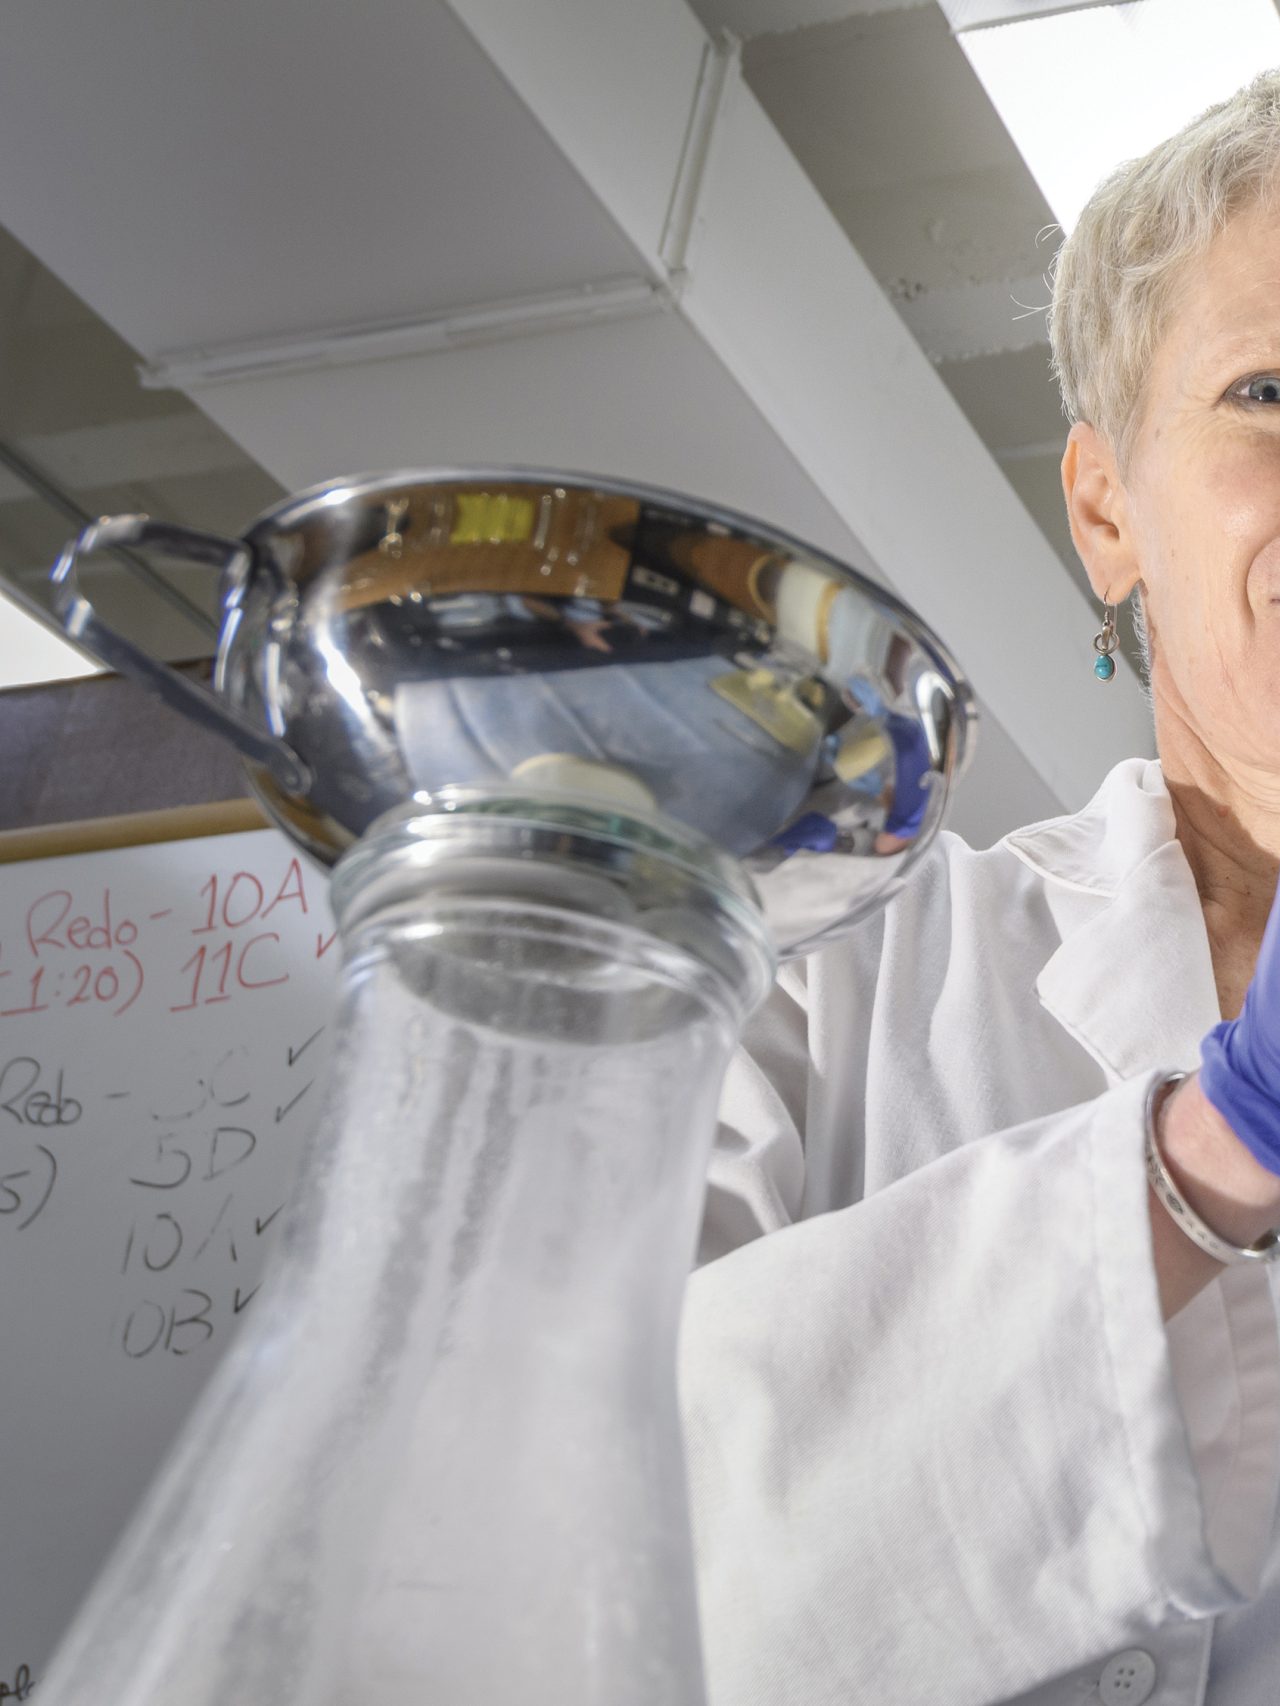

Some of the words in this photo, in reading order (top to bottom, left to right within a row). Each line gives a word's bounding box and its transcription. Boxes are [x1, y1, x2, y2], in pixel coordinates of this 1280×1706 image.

[26, 887, 139, 958] Redo
[192, 856, 309, 936] 10A
[169, 931, 290, 1013] 11C
